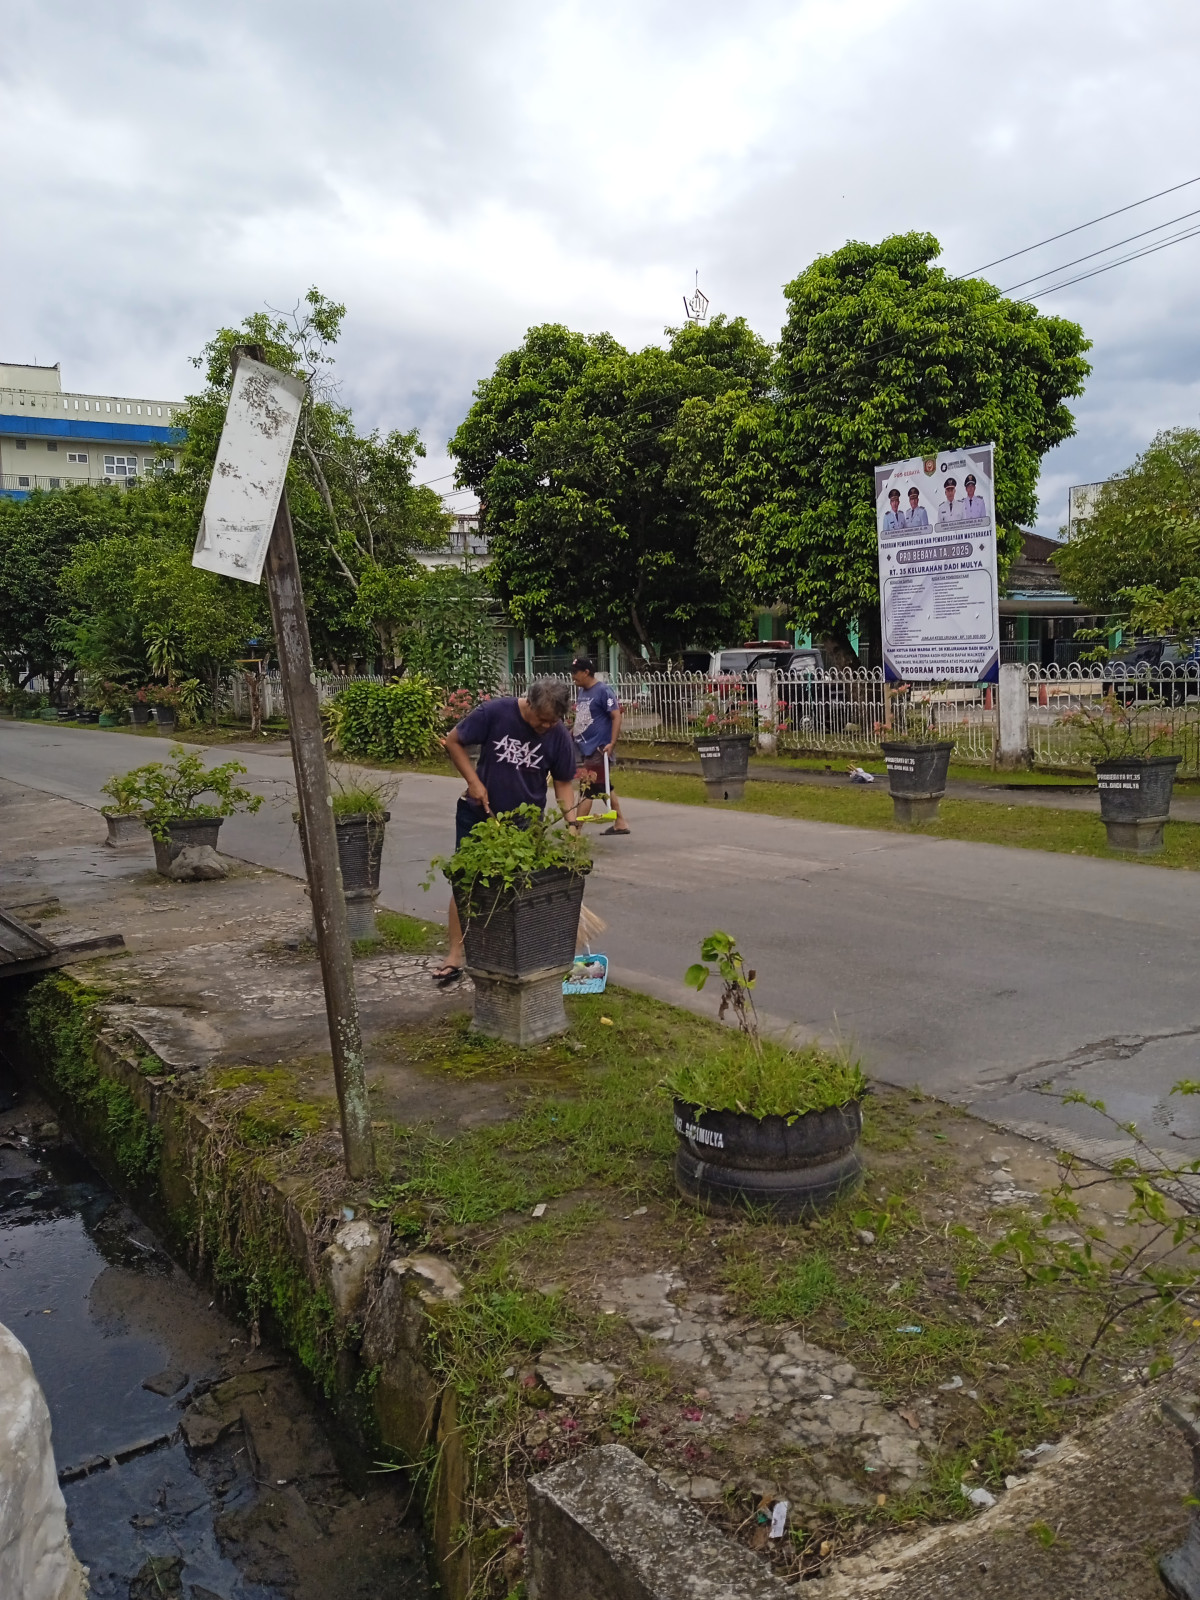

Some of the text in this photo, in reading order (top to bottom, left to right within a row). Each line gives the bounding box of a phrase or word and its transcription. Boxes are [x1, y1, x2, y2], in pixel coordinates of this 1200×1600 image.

[897, 539, 923, 547] PEMBANGUNAN
[933, 534, 964, 543] PEMBERDAYAAN
[964, 530, 992, 539] MASYARAKAT
[899, 545, 969, 561] PRO BEBAYA TA. 2025
[908, 565, 942, 574] KELURAHAN
[961, 560, 983, 569] MULYA
